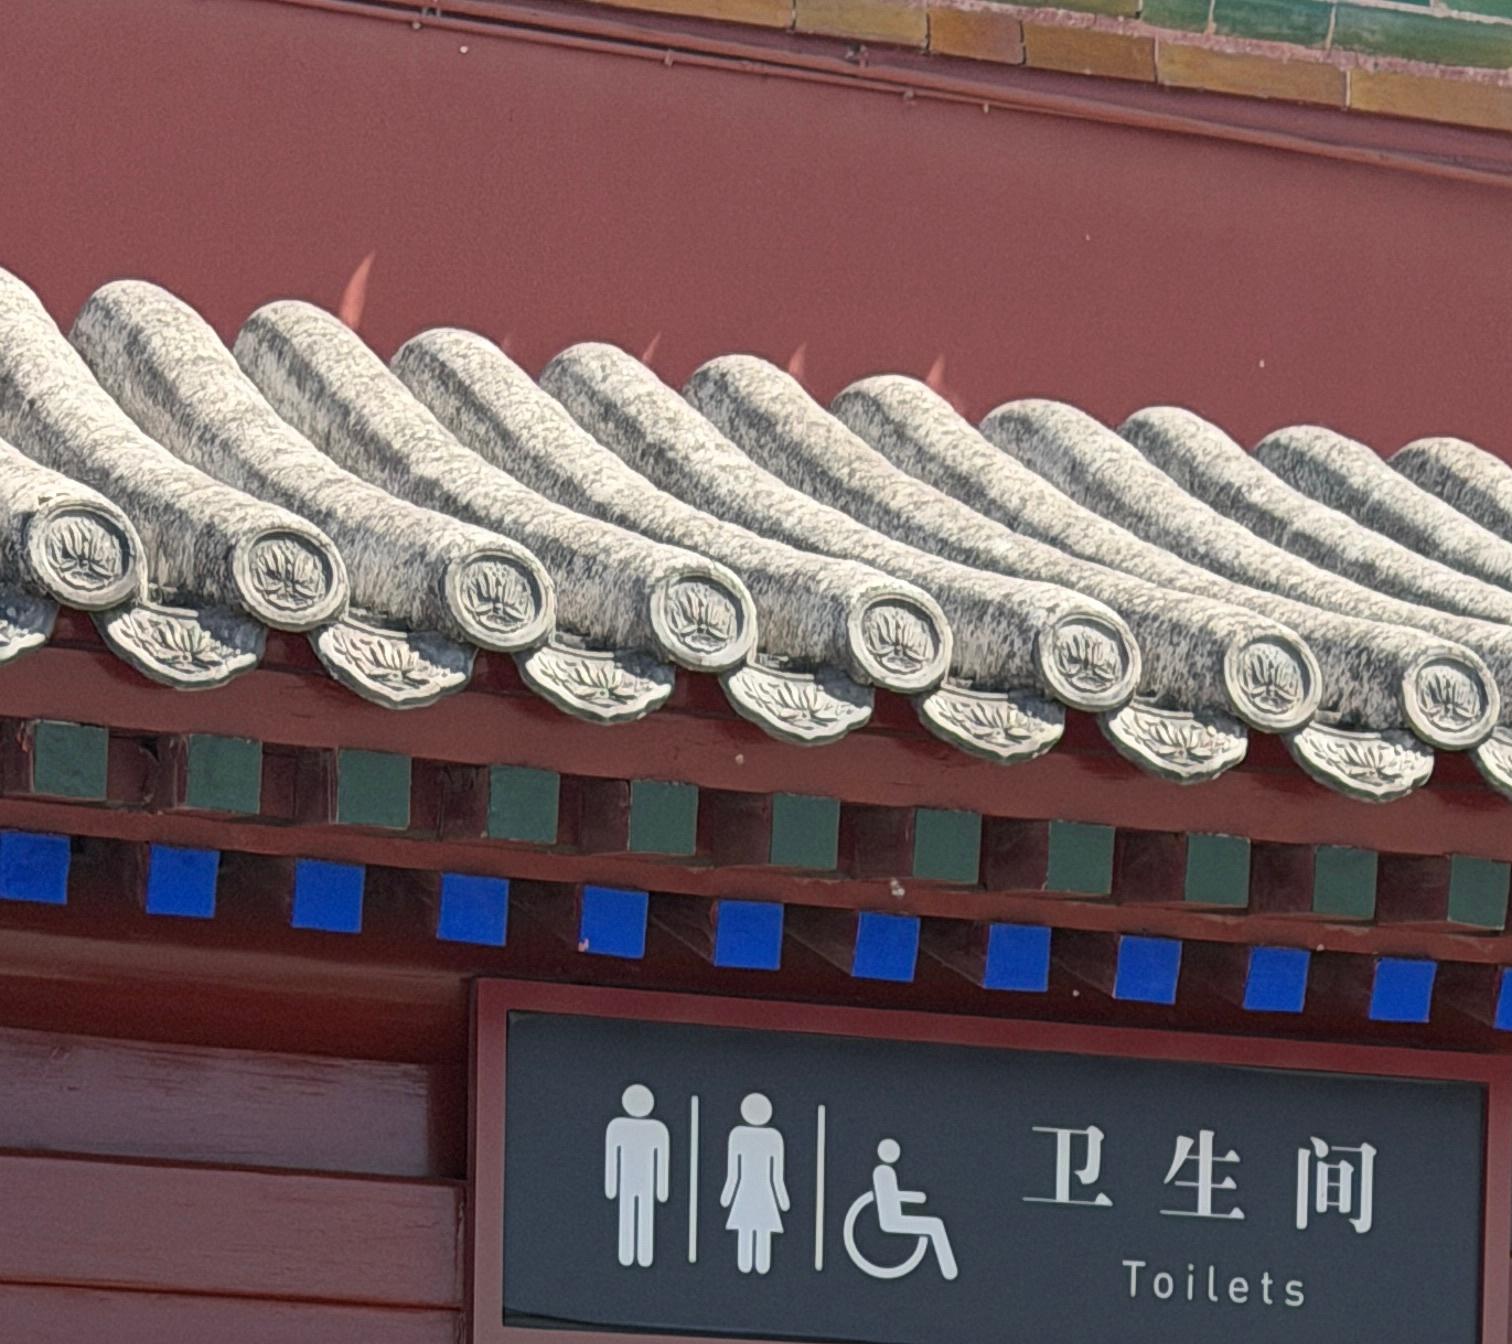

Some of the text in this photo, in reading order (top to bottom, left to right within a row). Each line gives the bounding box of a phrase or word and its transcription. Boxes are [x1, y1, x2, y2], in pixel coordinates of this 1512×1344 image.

[1022, 1124, 1378, 1234] 卫生间
[1121, 1259, 1305, 1308] Toilets
